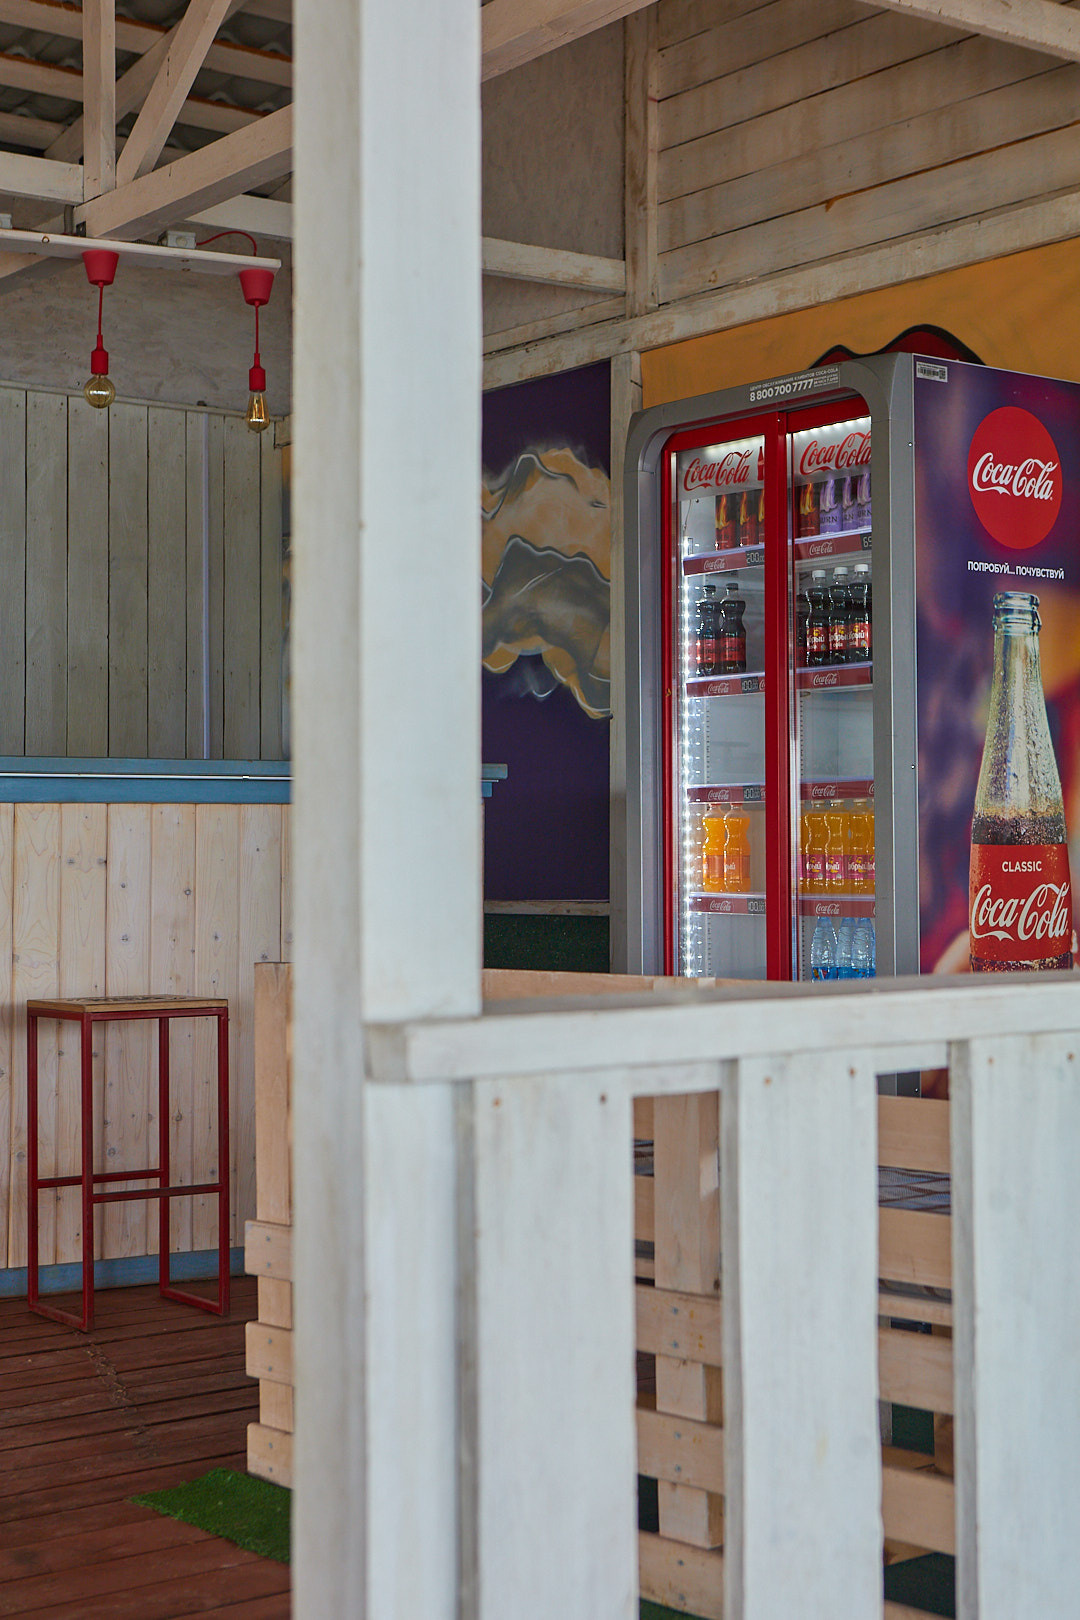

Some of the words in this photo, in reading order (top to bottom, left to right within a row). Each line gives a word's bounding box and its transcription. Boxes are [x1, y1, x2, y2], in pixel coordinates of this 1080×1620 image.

[750, 392, 756, 402] 8
[756, 388, 774, 400] 800
[774, 384, 792, 396] 700
[792, 379, 814, 392] 7777
[683, 449, 753, 491] Coca-Cola
[972, 452, 1058, 500] Coca-Cola
[1002, 860, 1042, 873] CLASSIC
[971, 881, 1070, 941] Coca-Cola
